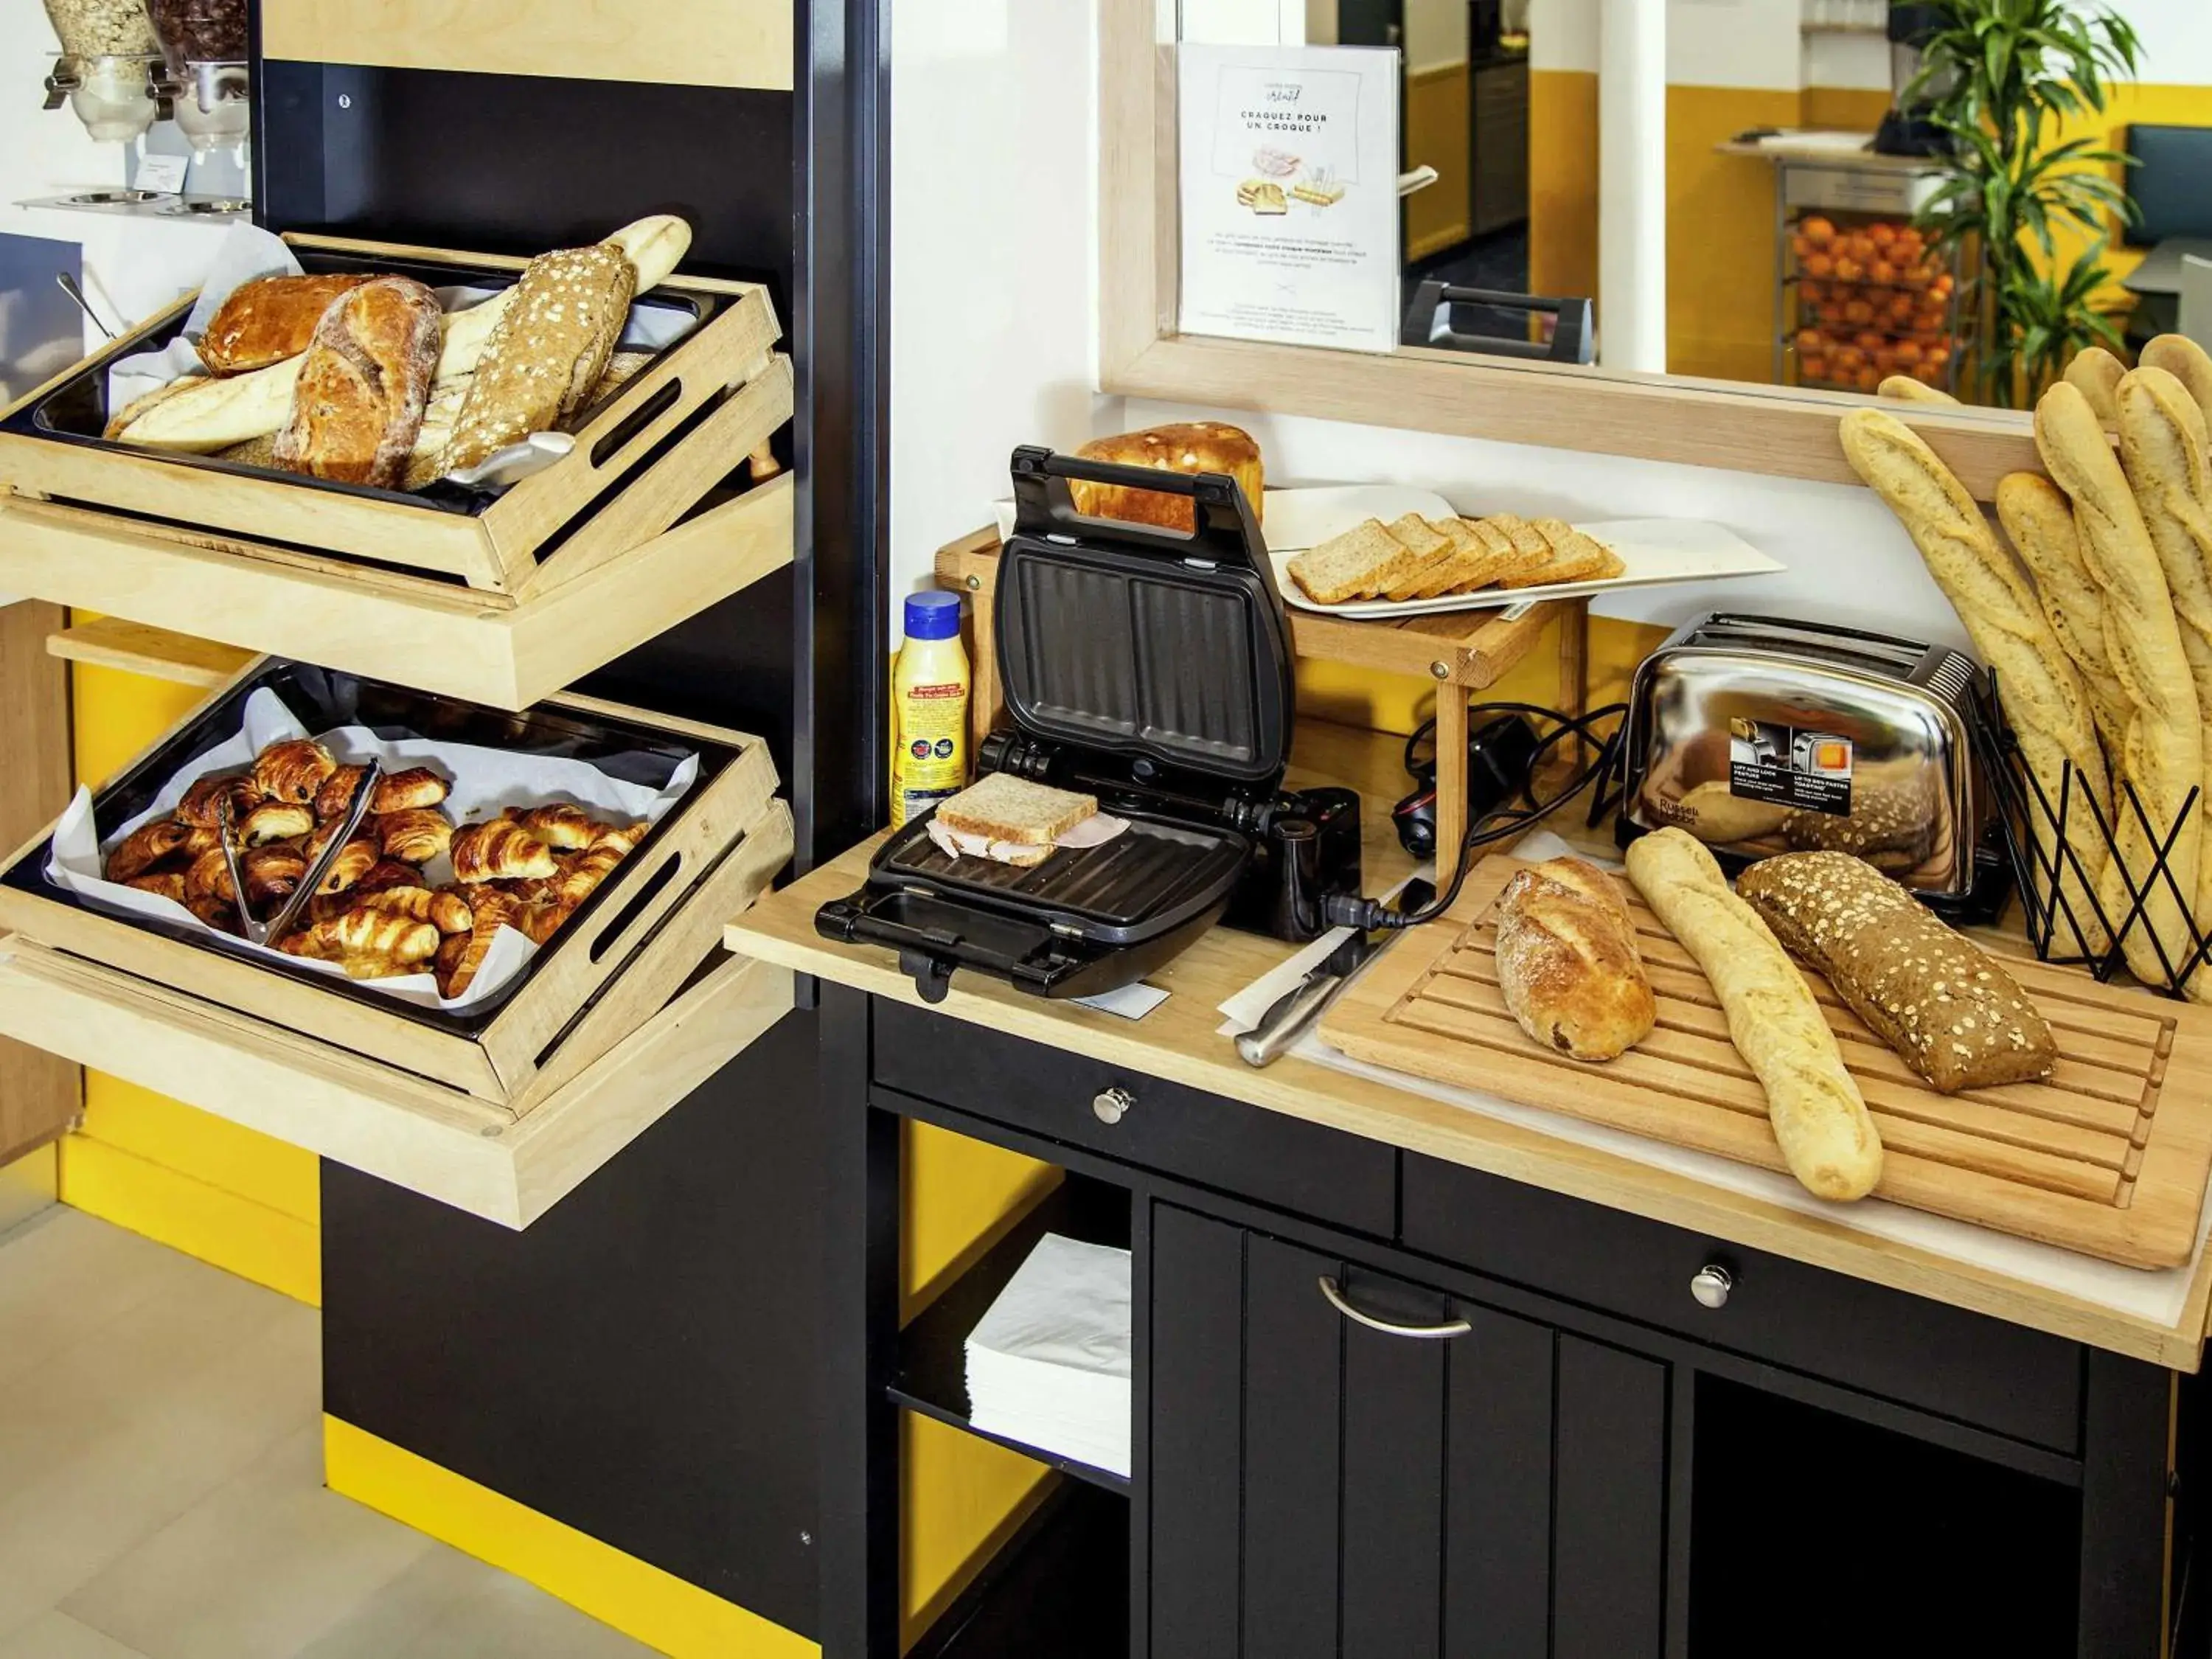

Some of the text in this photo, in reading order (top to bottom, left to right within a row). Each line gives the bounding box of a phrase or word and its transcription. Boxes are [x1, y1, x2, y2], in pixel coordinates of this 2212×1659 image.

[1240, 111, 1327, 122] CRAQUEZ POUR
[1246, 121, 1262, 130] UN
[1267, 122, 1312, 133] CROQUE
